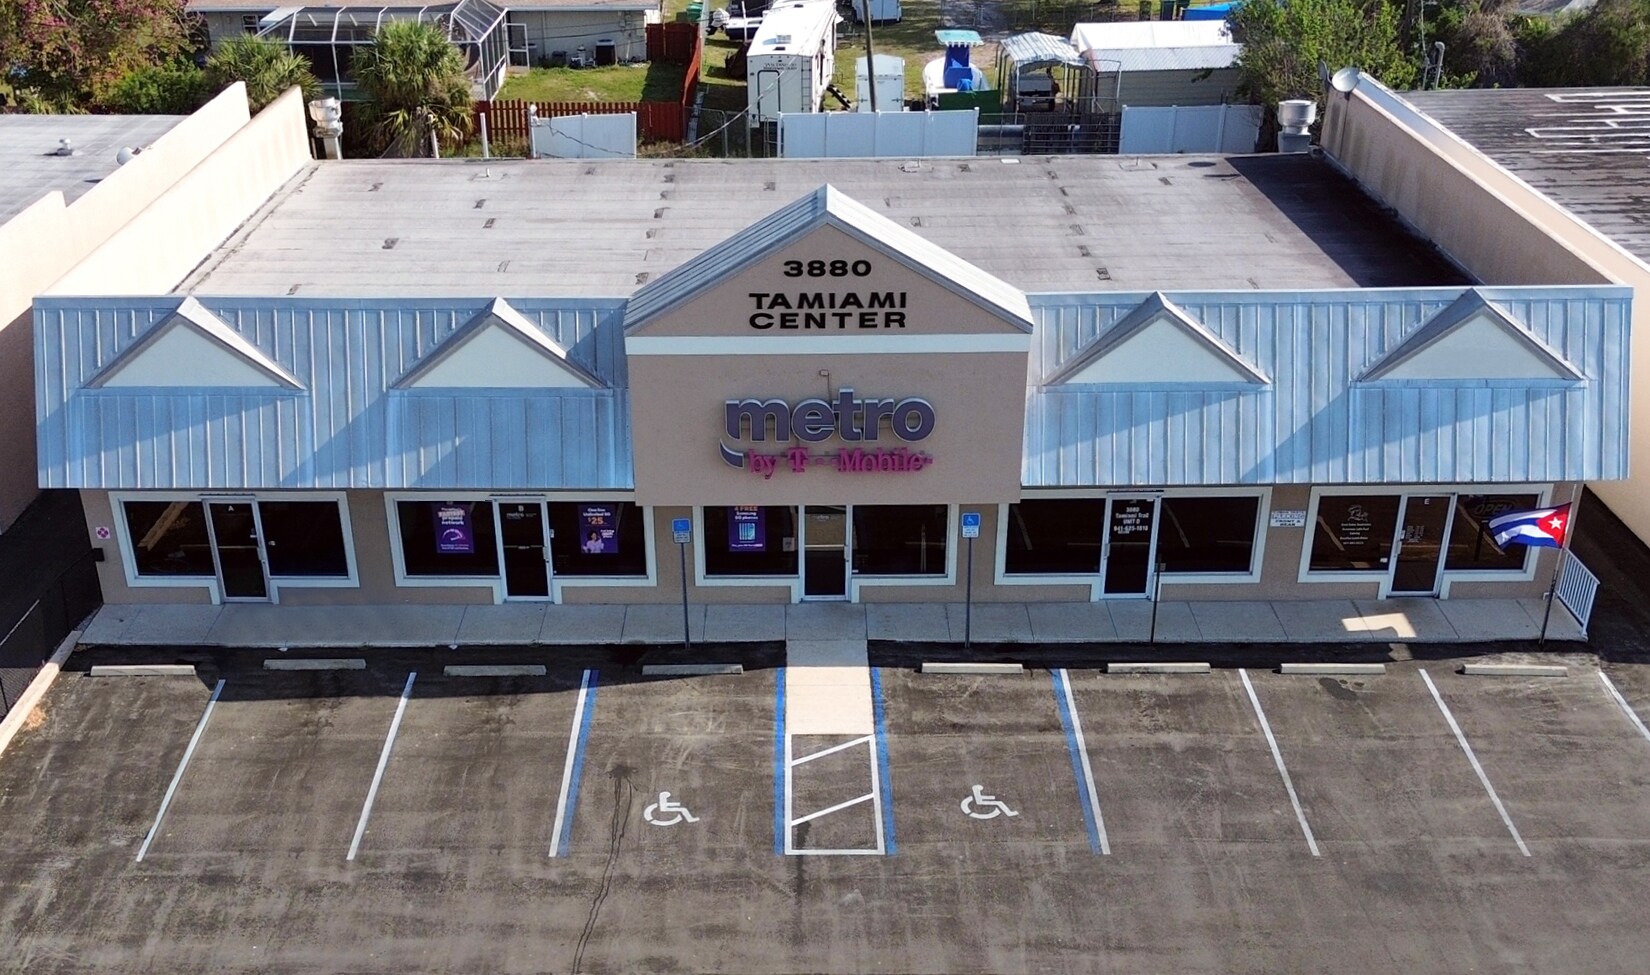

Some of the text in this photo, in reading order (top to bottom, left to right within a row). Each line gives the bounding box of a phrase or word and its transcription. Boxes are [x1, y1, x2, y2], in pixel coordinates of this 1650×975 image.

[783, 260, 872, 277] 3880
[748, 292, 907, 309] TAMIAMI
[749, 312, 906, 329] CENTER
[724, 388, 936, 443] metro
[748, 449, 777, 479] by
